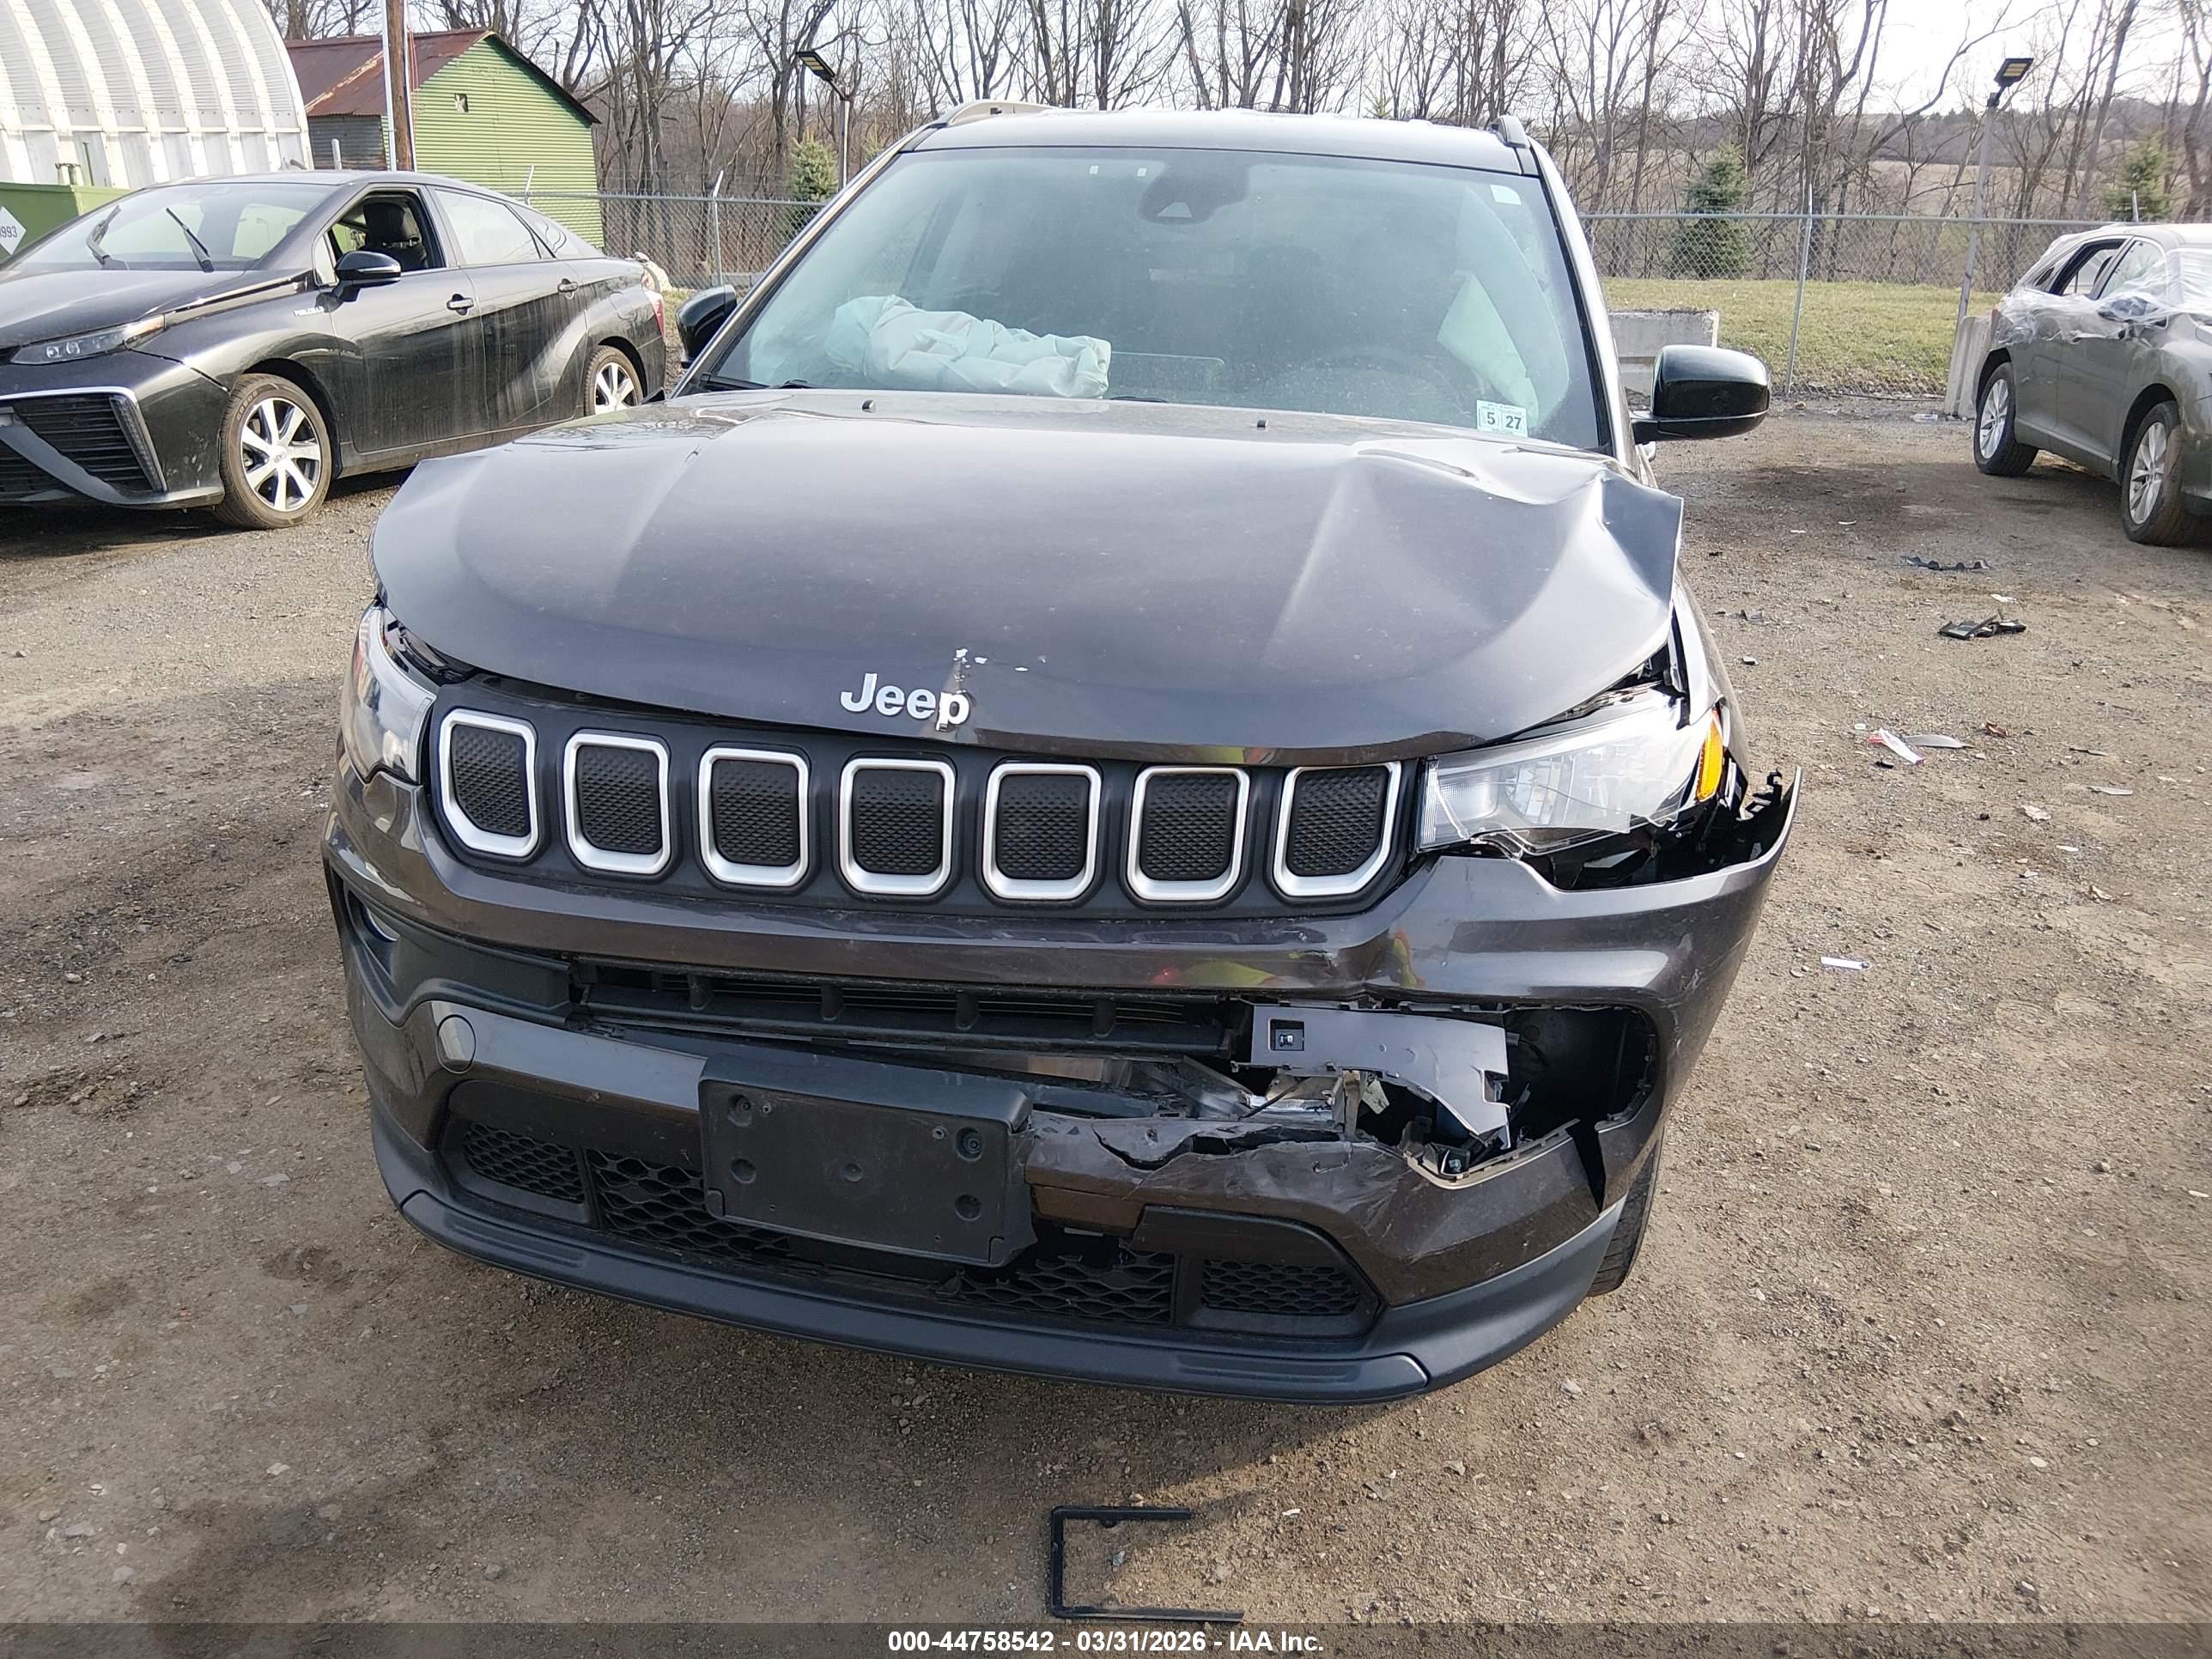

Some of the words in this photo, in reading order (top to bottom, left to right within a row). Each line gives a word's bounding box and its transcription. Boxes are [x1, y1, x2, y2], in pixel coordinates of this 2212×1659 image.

[1487, 411, 1496, 425] 5
[1505, 415, 1522, 429] 27
[840, 672, 970, 732] Jeep
